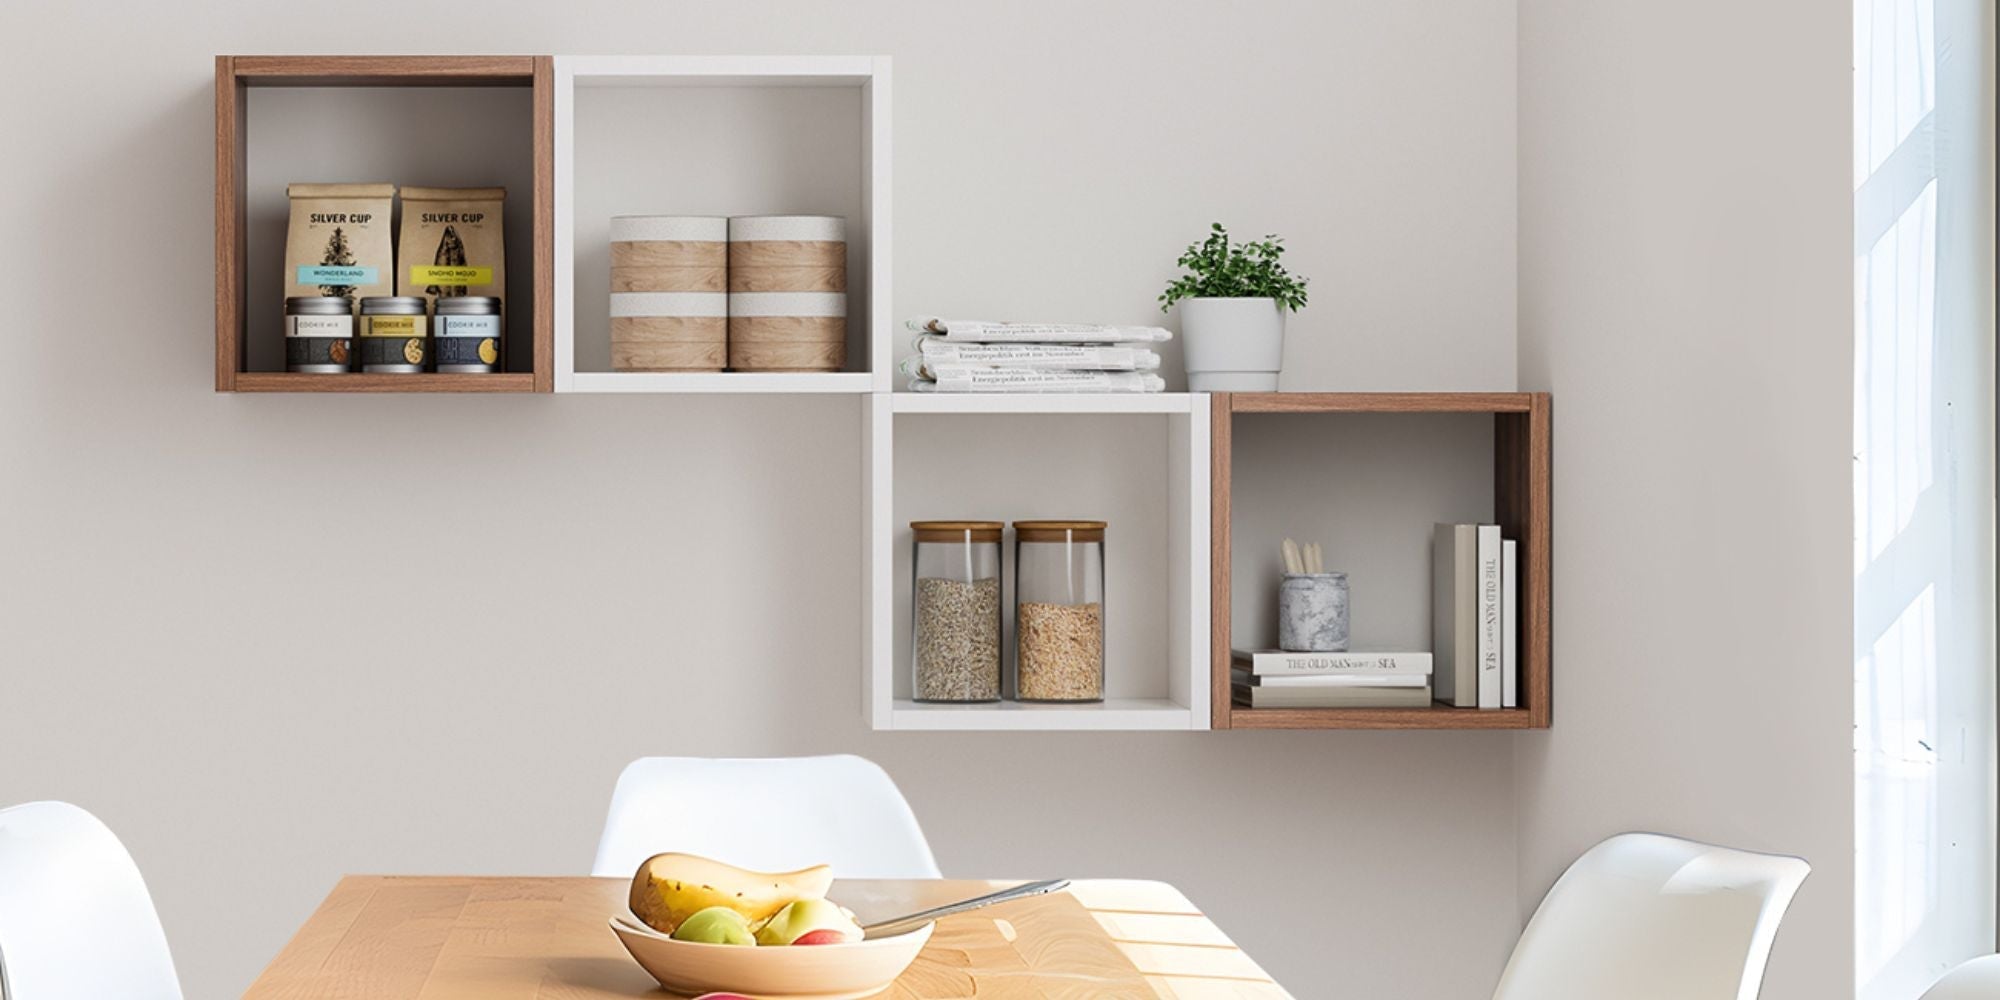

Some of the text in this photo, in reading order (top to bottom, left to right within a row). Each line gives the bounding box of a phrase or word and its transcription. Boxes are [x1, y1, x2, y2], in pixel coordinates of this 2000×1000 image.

[310, 213, 372, 223] SILVER CUP
[421, 213, 484, 223] SILVER CUP
[1486, 559, 1496, 578] THE
[1486, 580, 1496, 602] OLD
[1486, 603, 1496, 624] MAN
[1286, 658, 1306, 669] THE
[1307, 658, 1328, 669] OLD
[1329, 658, 1351, 669] MAN
[1378, 658, 1396, 669] SEA
[1486, 652, 1496, 671] SEA
